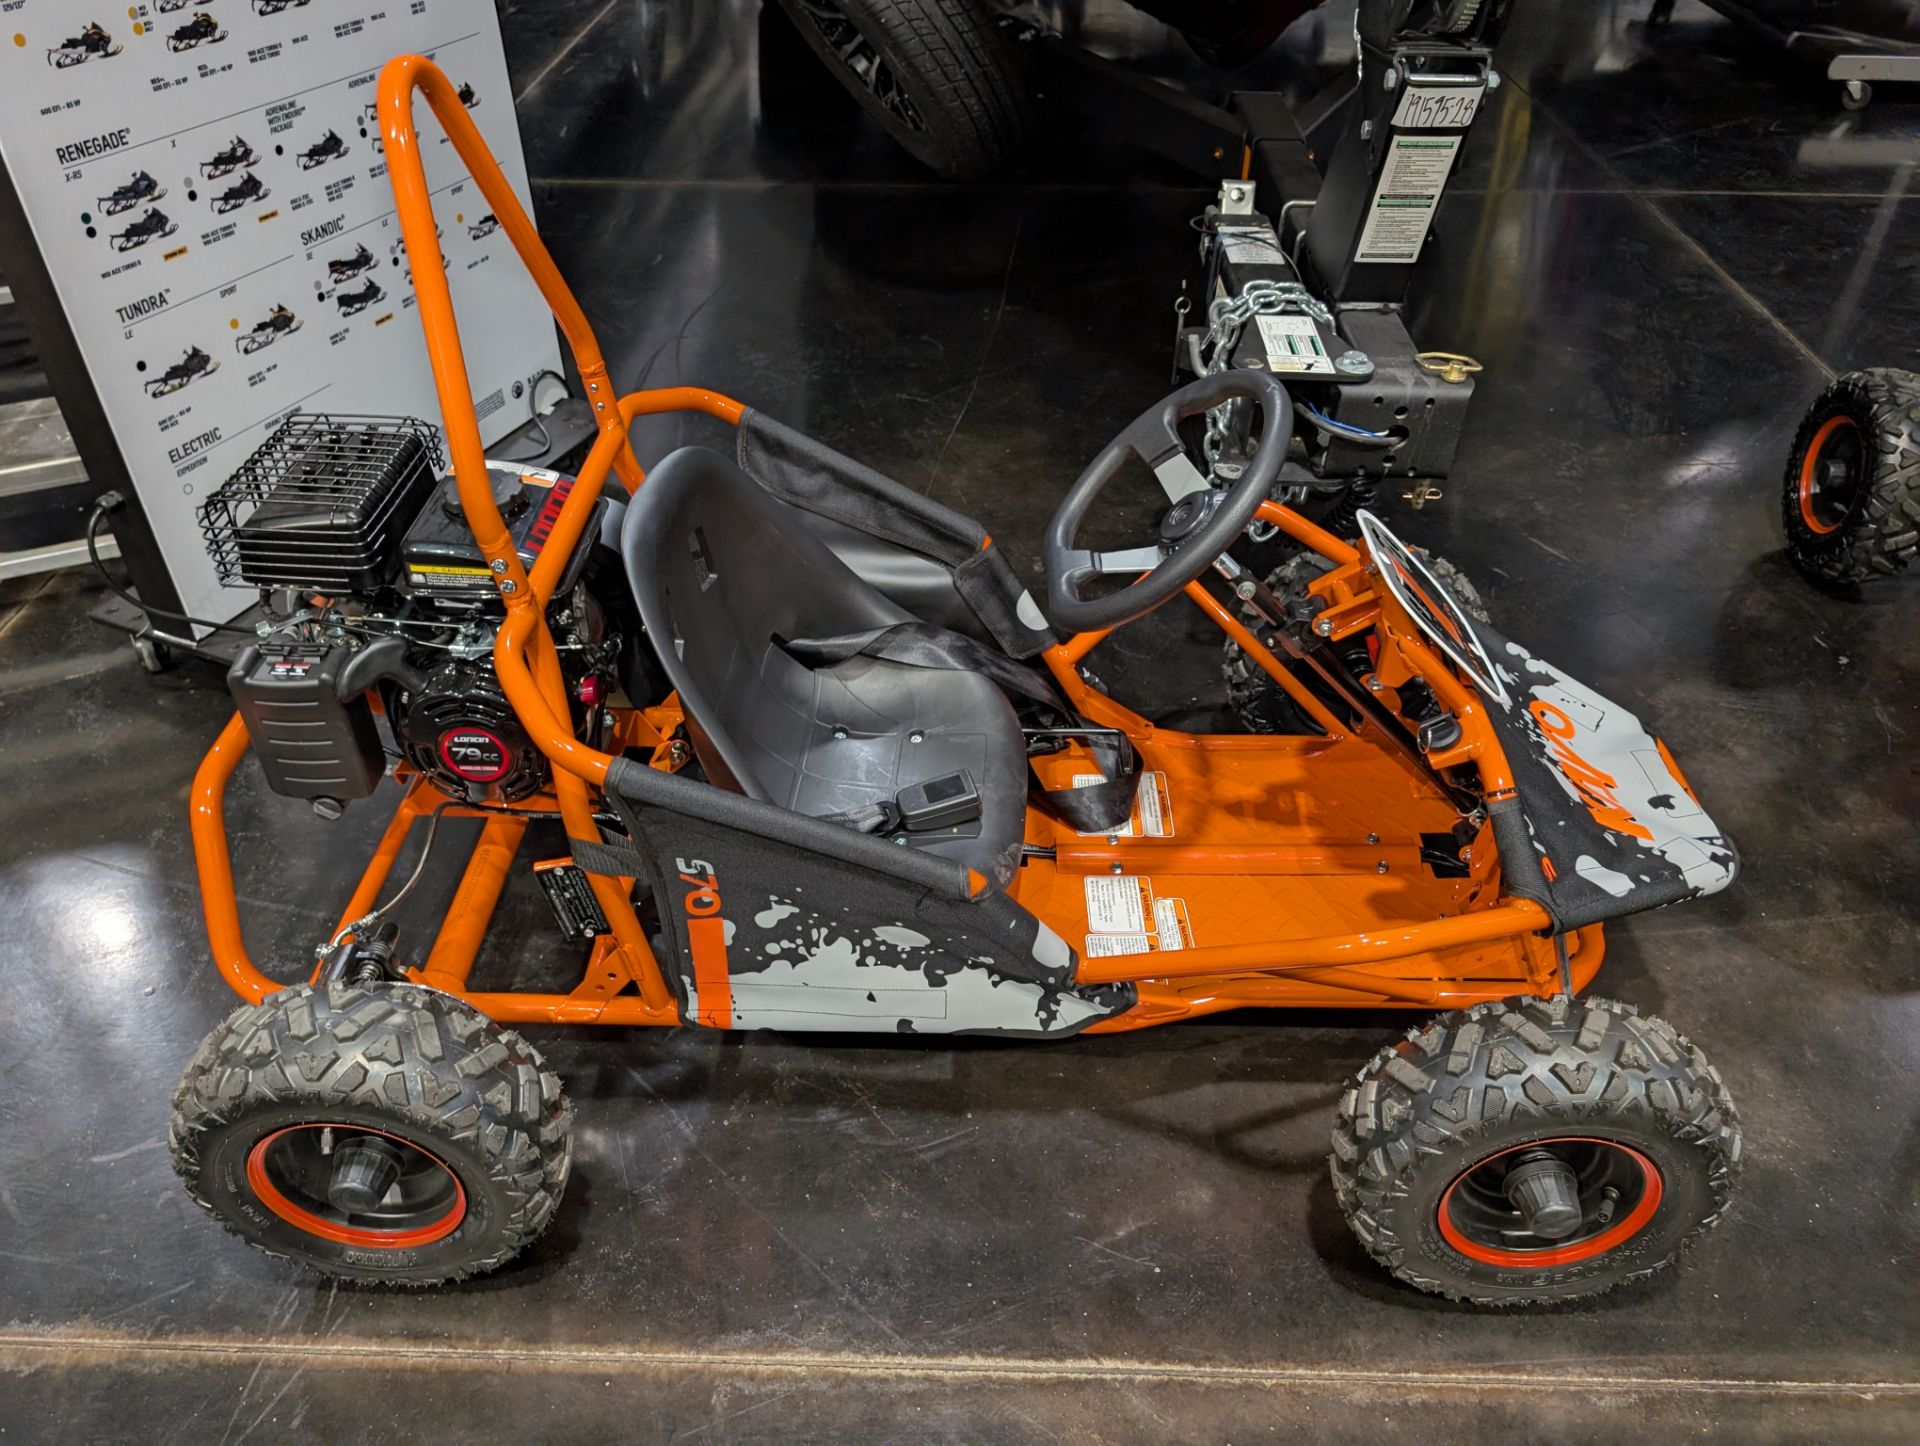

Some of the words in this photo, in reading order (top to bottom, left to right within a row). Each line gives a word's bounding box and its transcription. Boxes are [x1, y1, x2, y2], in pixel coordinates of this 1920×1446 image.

[348, 73, 376, 89] ADRENALINE
[265, 100, 297, 118] ADRENALINE
[268, 115, 281, 126] WITH
[270, 122, 294, 135] PACKAGE
[171, 138, 176, 148] X
[65, 170, 82, 183] X-RS
[112, 267, 121, 276] ACE
[220, 285, 237, 298] SPORT
[125, 329, 134, 340] LE
[168, 427, 222, 464] ELECTRIC
[177, 456, 208, 478] EXPEDITION
[1142, 893, 1153, 922] WARNING
